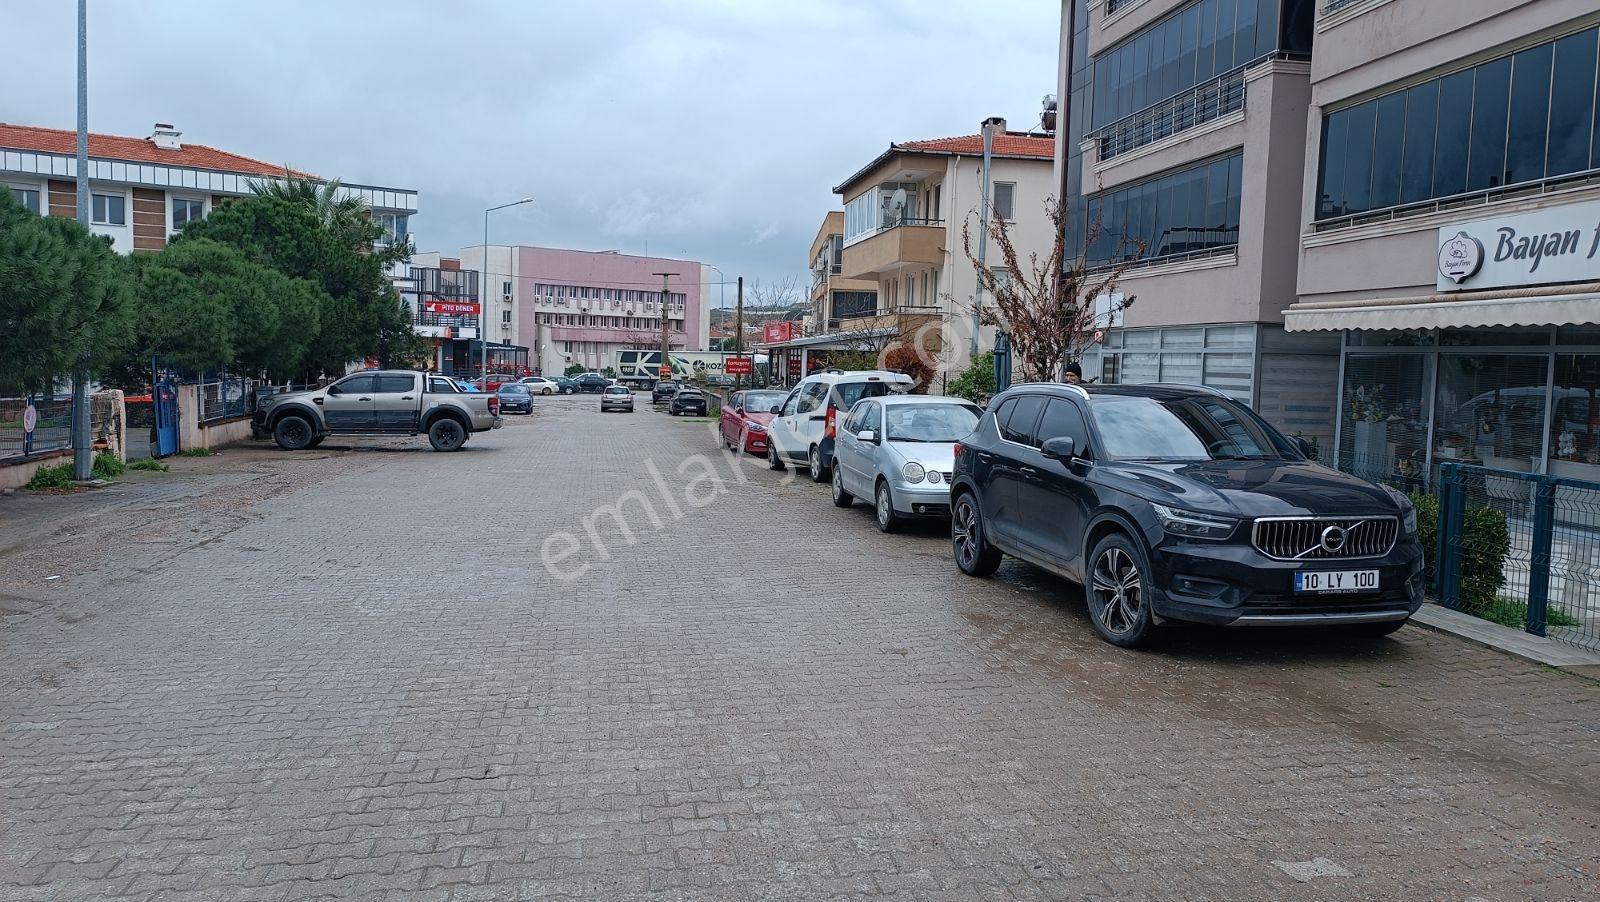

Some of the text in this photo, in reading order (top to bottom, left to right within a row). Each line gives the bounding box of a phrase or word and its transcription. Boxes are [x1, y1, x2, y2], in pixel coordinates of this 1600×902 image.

[1494, 227, 1581, 273] Bayan
[706, 362, 726, 370] KOZ
[1304, 574, 1319, 589] 10
[1328, 573, 1343, 588] LY
[1353, 572, 1375, 587] 100
